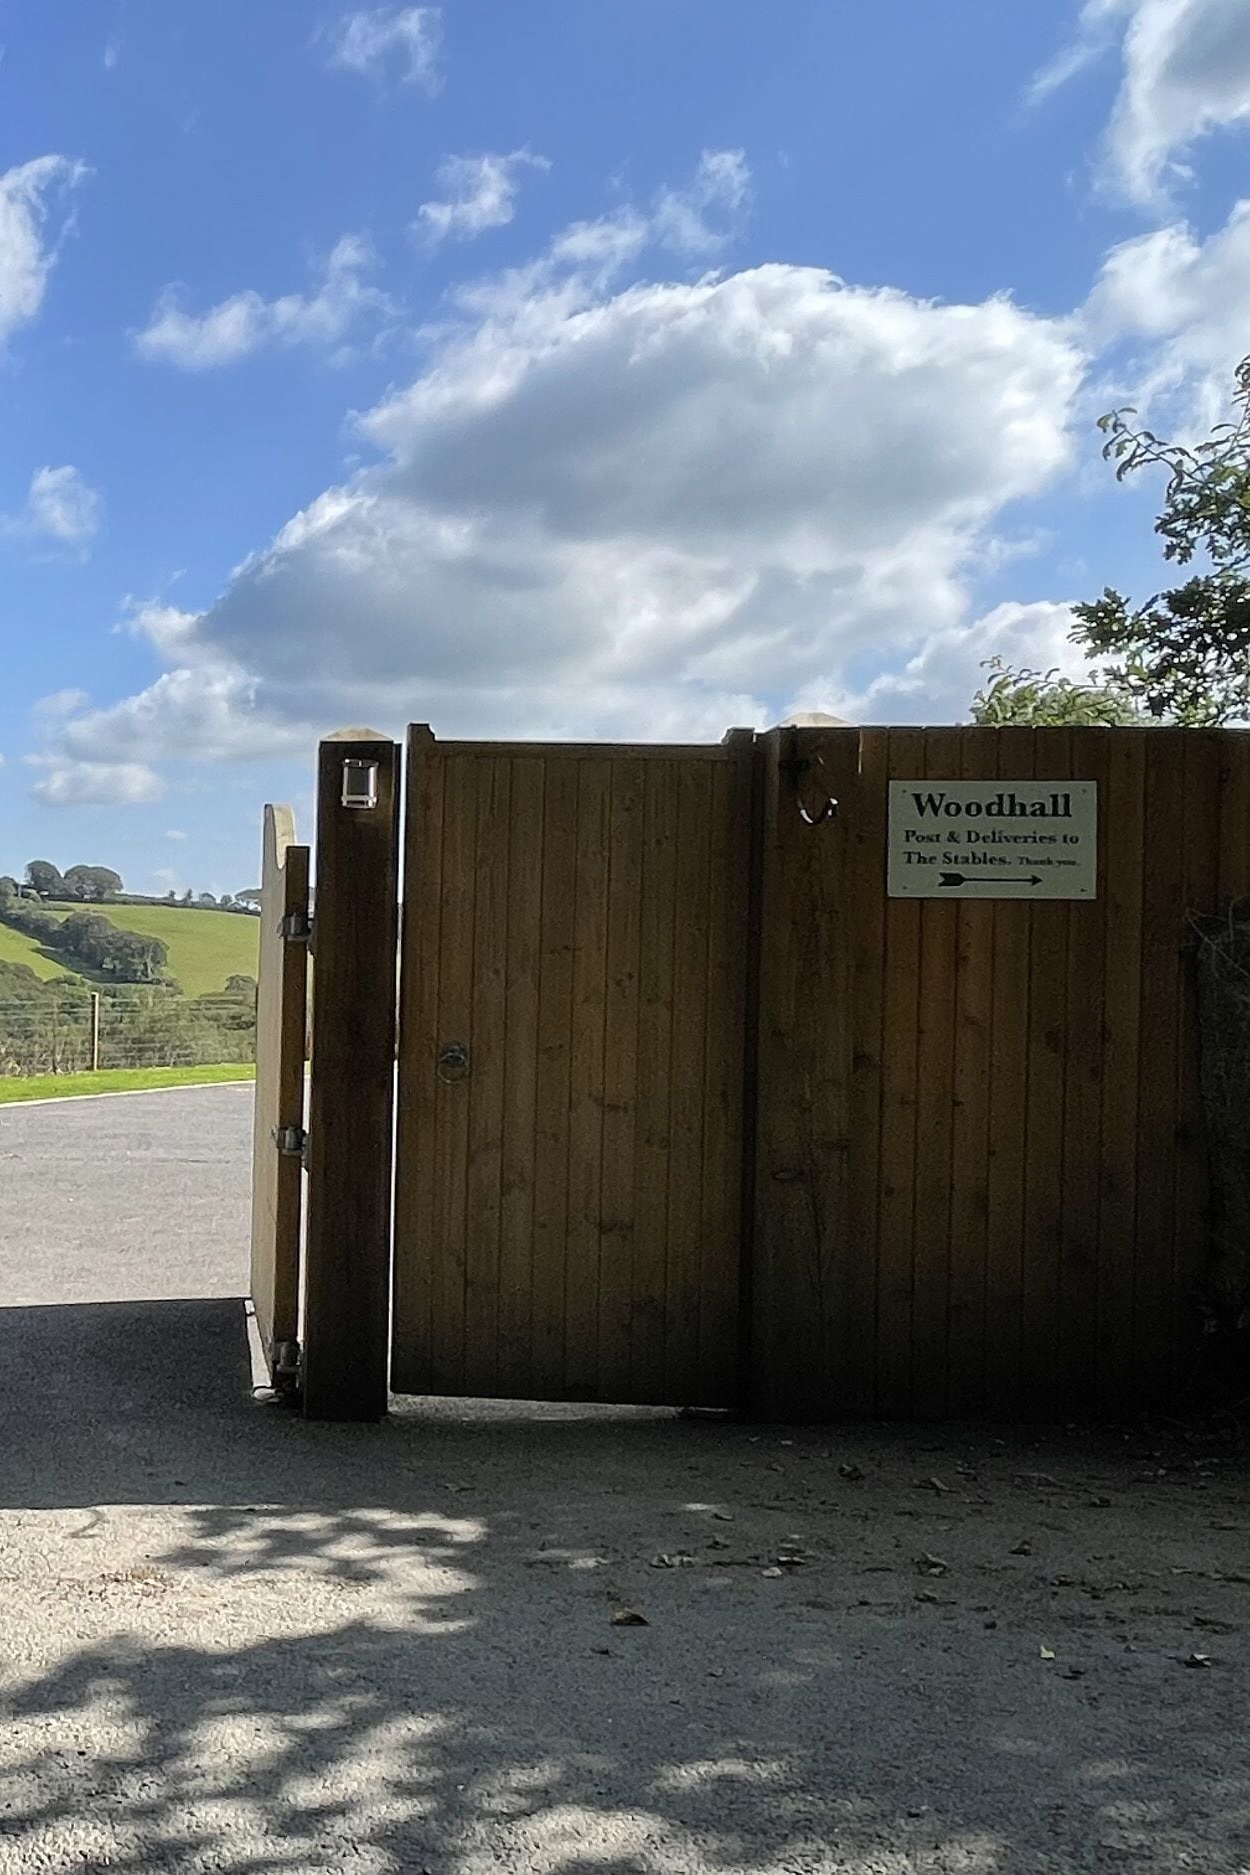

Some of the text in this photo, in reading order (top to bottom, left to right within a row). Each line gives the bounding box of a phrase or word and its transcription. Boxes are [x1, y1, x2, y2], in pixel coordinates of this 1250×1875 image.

[911, 792, 1073, 818] Woodhall
[904, 829, 1079, 845] Post & Deliveries to
[903, 851, 937, 865] The
[942, 850, 1012, 866] Stables.
[1018, 856, 1053, 866] Thank
